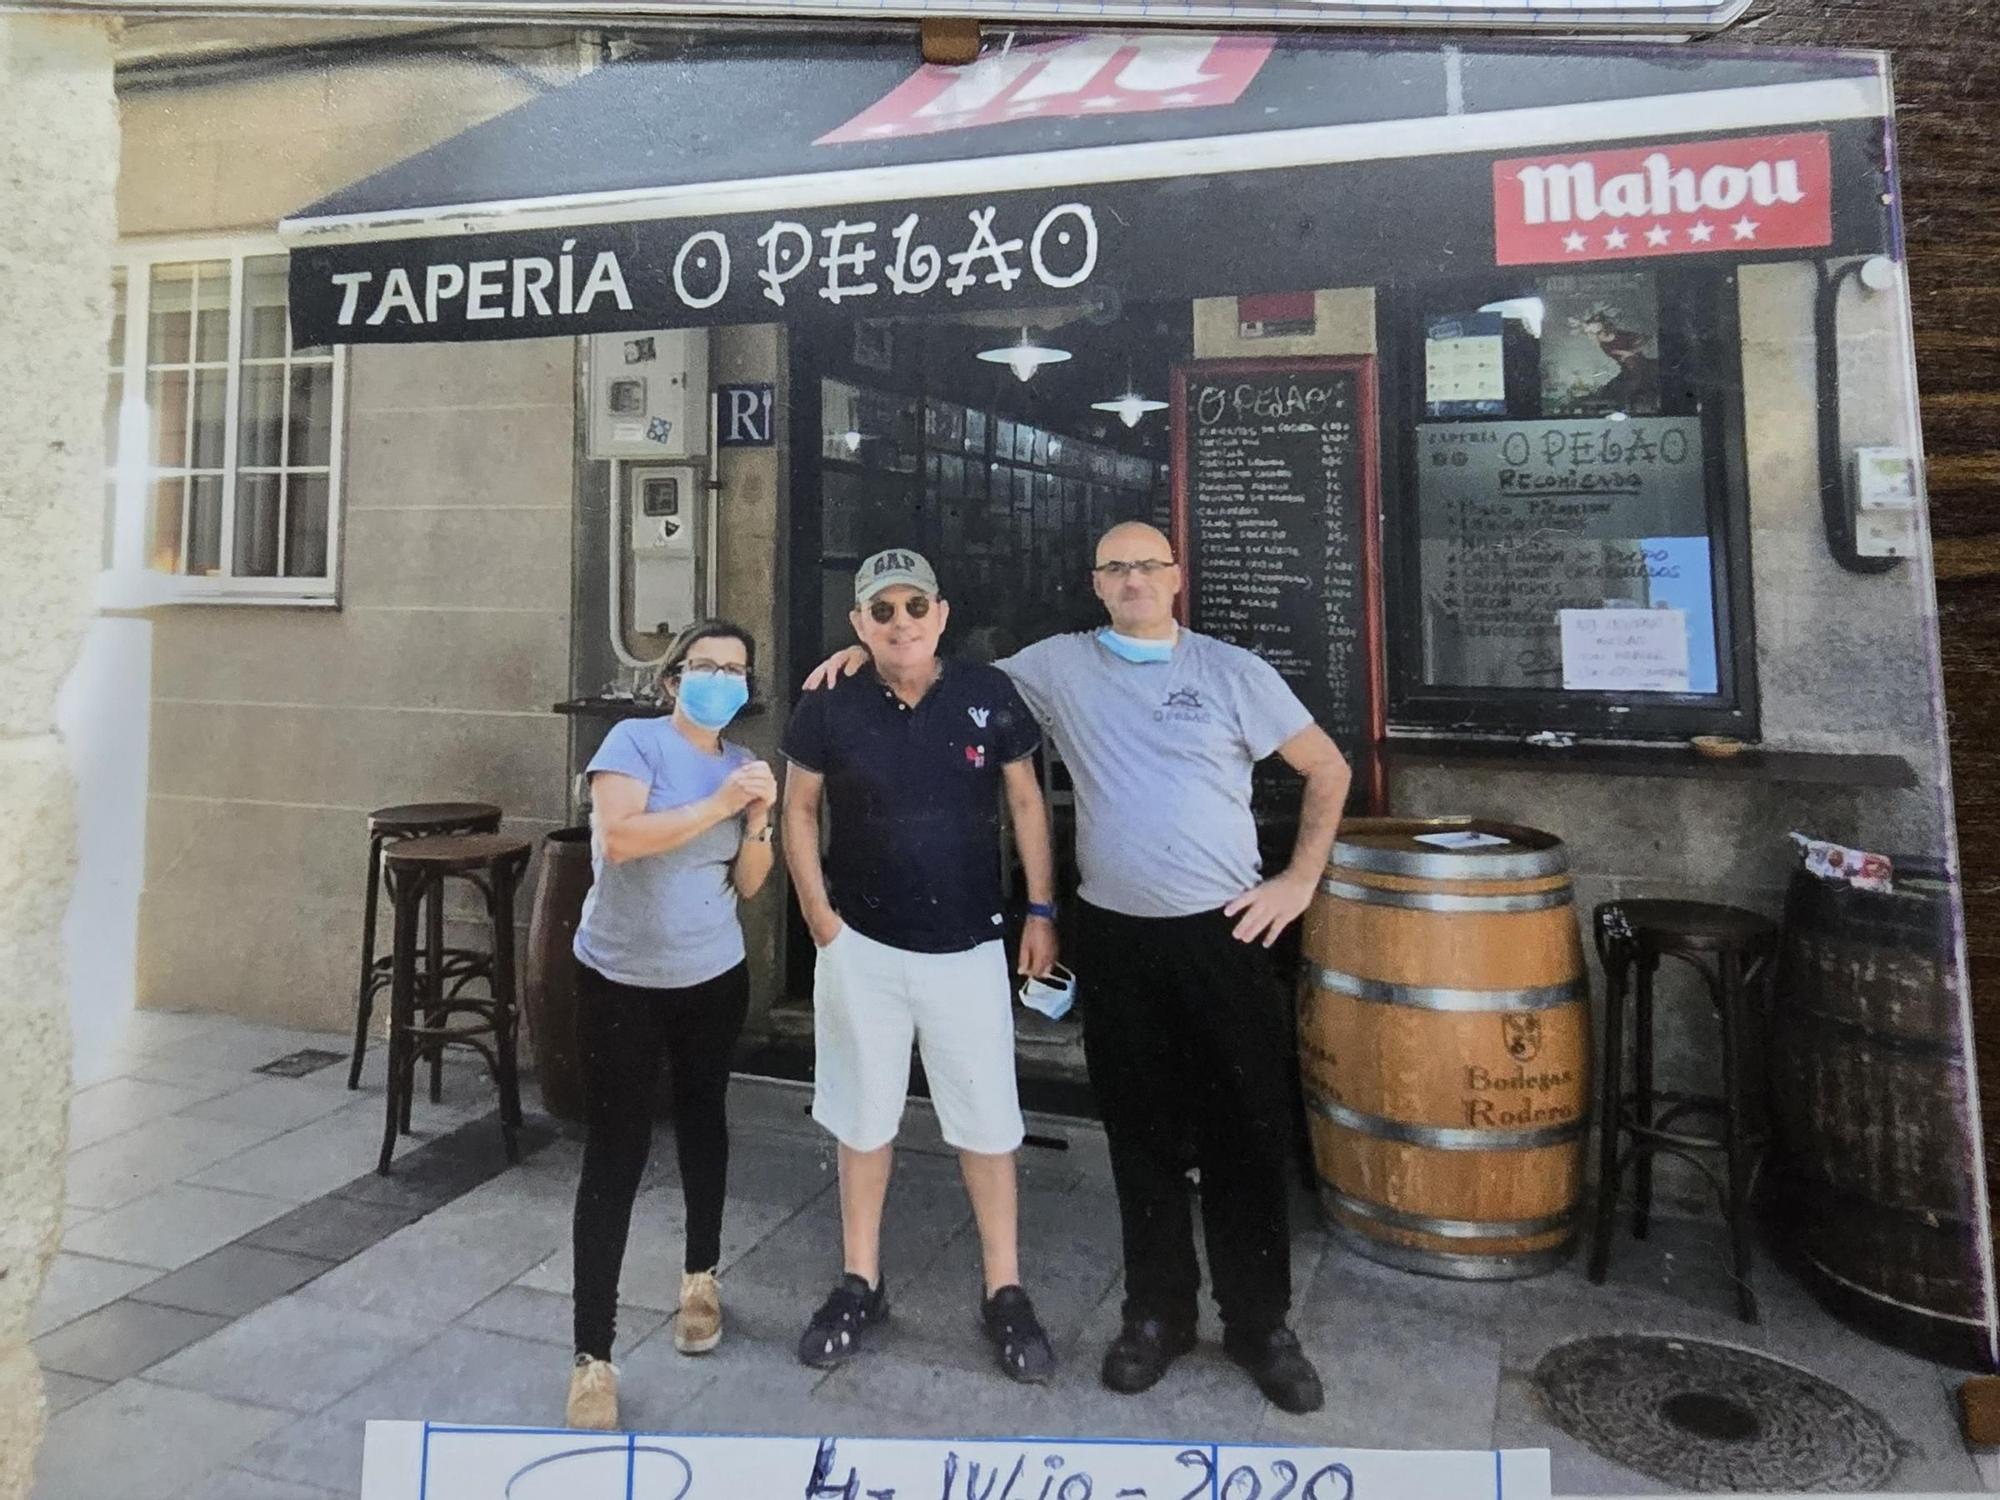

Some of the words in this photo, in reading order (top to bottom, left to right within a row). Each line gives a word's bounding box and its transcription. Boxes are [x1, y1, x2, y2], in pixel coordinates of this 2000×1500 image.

[1515, 152, 1809, 225] Mahou
[331, 238, 633, 326] TAPERÍA
[673, 230, 731, 309] O
[756, 205, 1099, 306] PELAO
[1502, 431, 1530, 467] O
[1539, 427, 1688, 467] PELAO
[874, 552, 916, 576] GAP
[1464, 1064, 1575, 1092] Bodegas
[1461, 1096, 1574, 1127] Rodero
